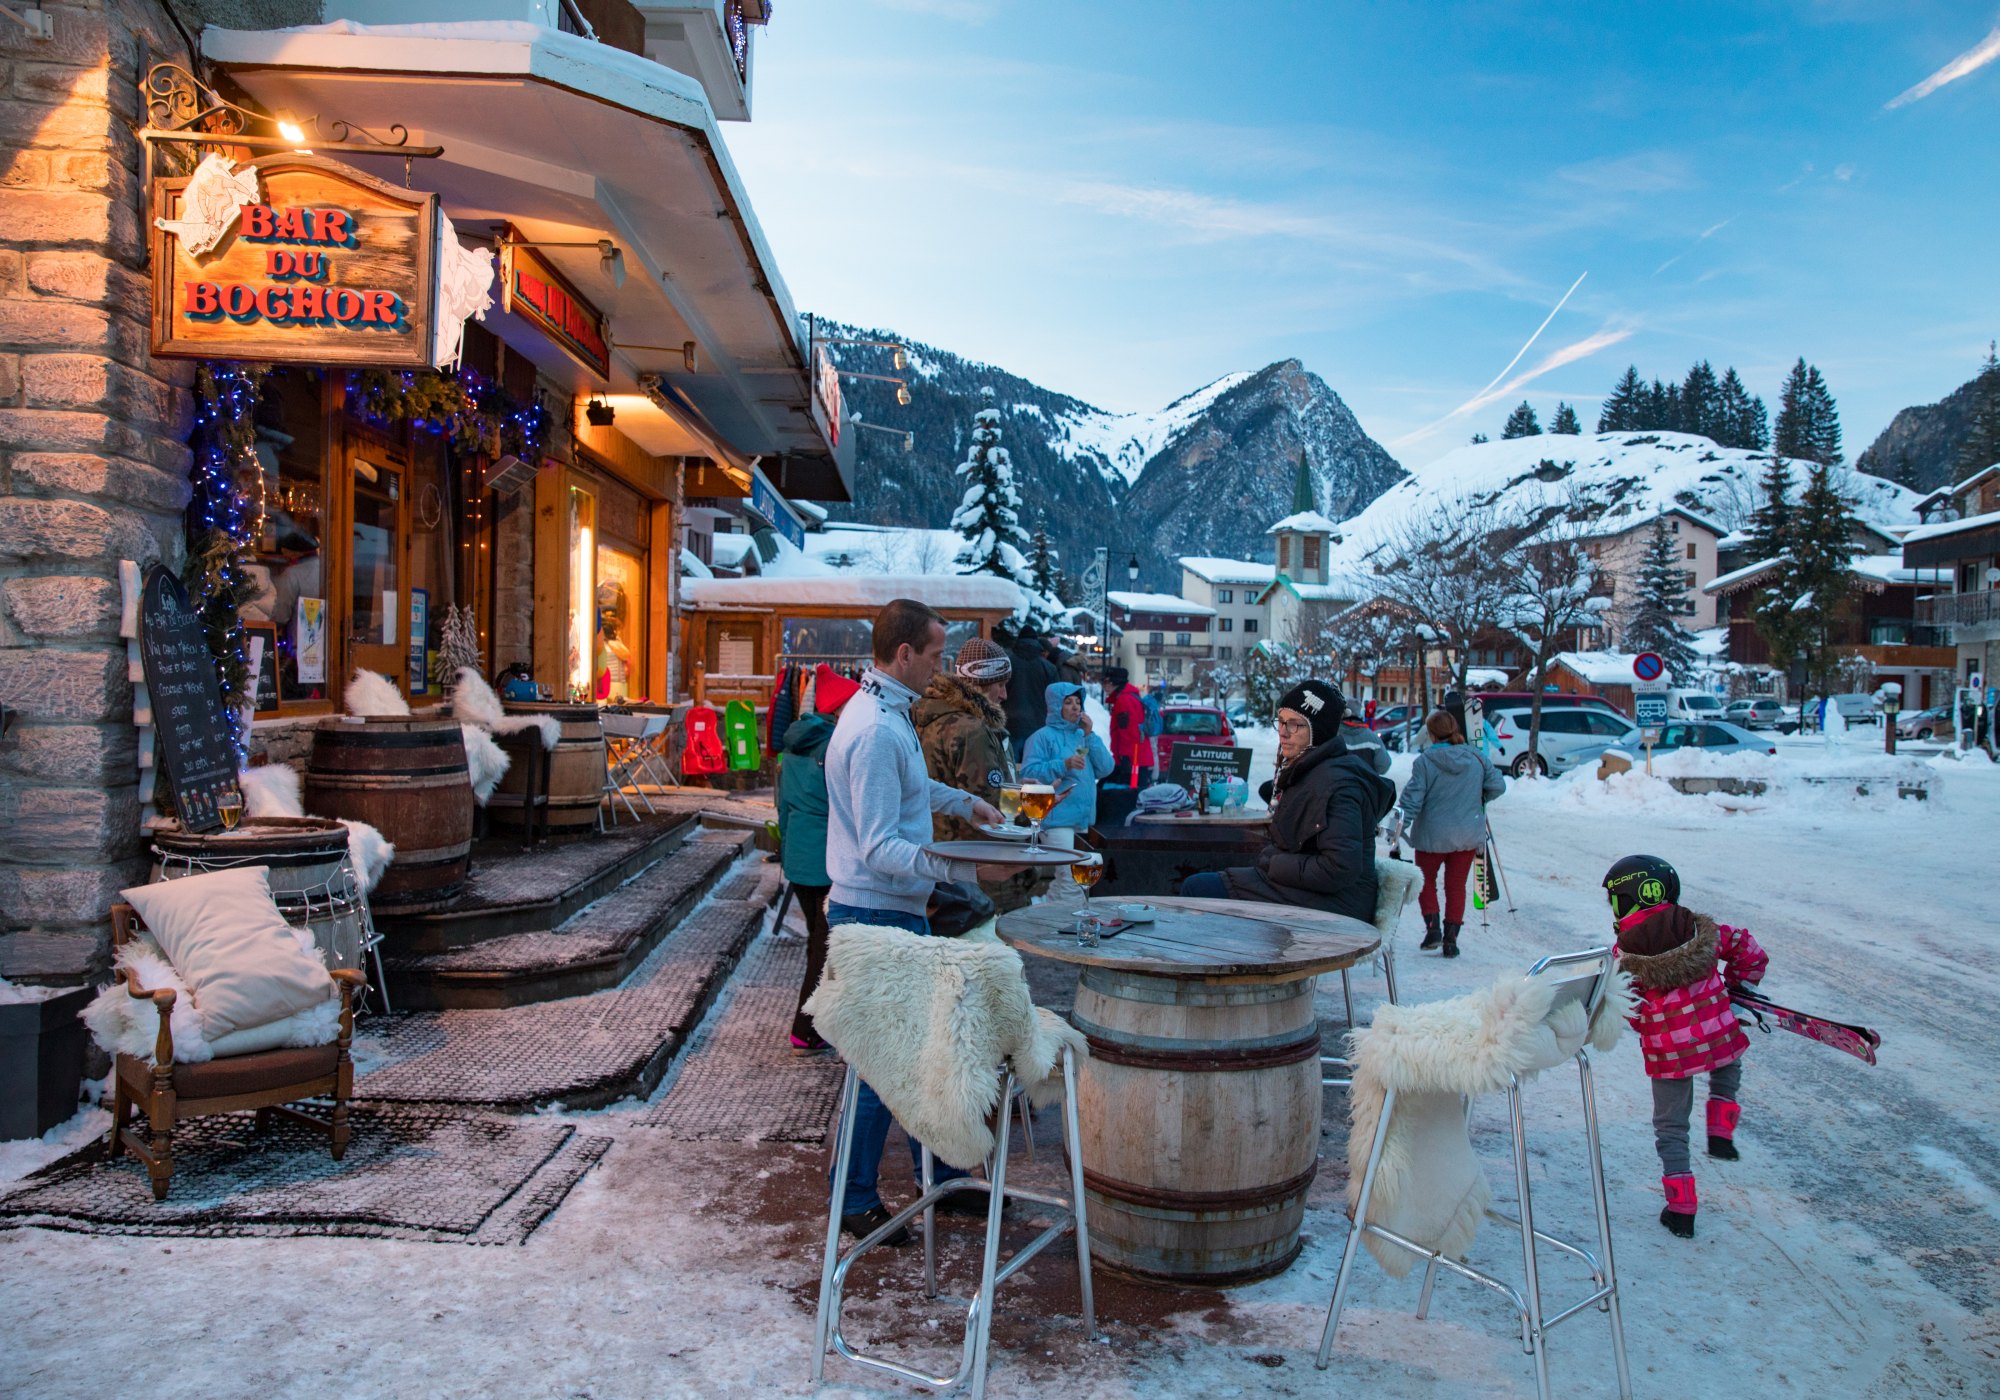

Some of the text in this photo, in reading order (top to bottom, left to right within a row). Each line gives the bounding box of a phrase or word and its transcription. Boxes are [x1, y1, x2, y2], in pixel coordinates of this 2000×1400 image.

[239, 204, 352, 247] BAR
[265, 249, 328, 279] DU
[184, 281, 401, 327] BOCHOR
[1190, 749, 1234, 760] LATITUDE
[1182, 763, 1212, 772] Location
[1213, 765, 1222, 773] de
[1613, 870, 1649, 886] cairn
[1642, 881, 1662, 899] 48
